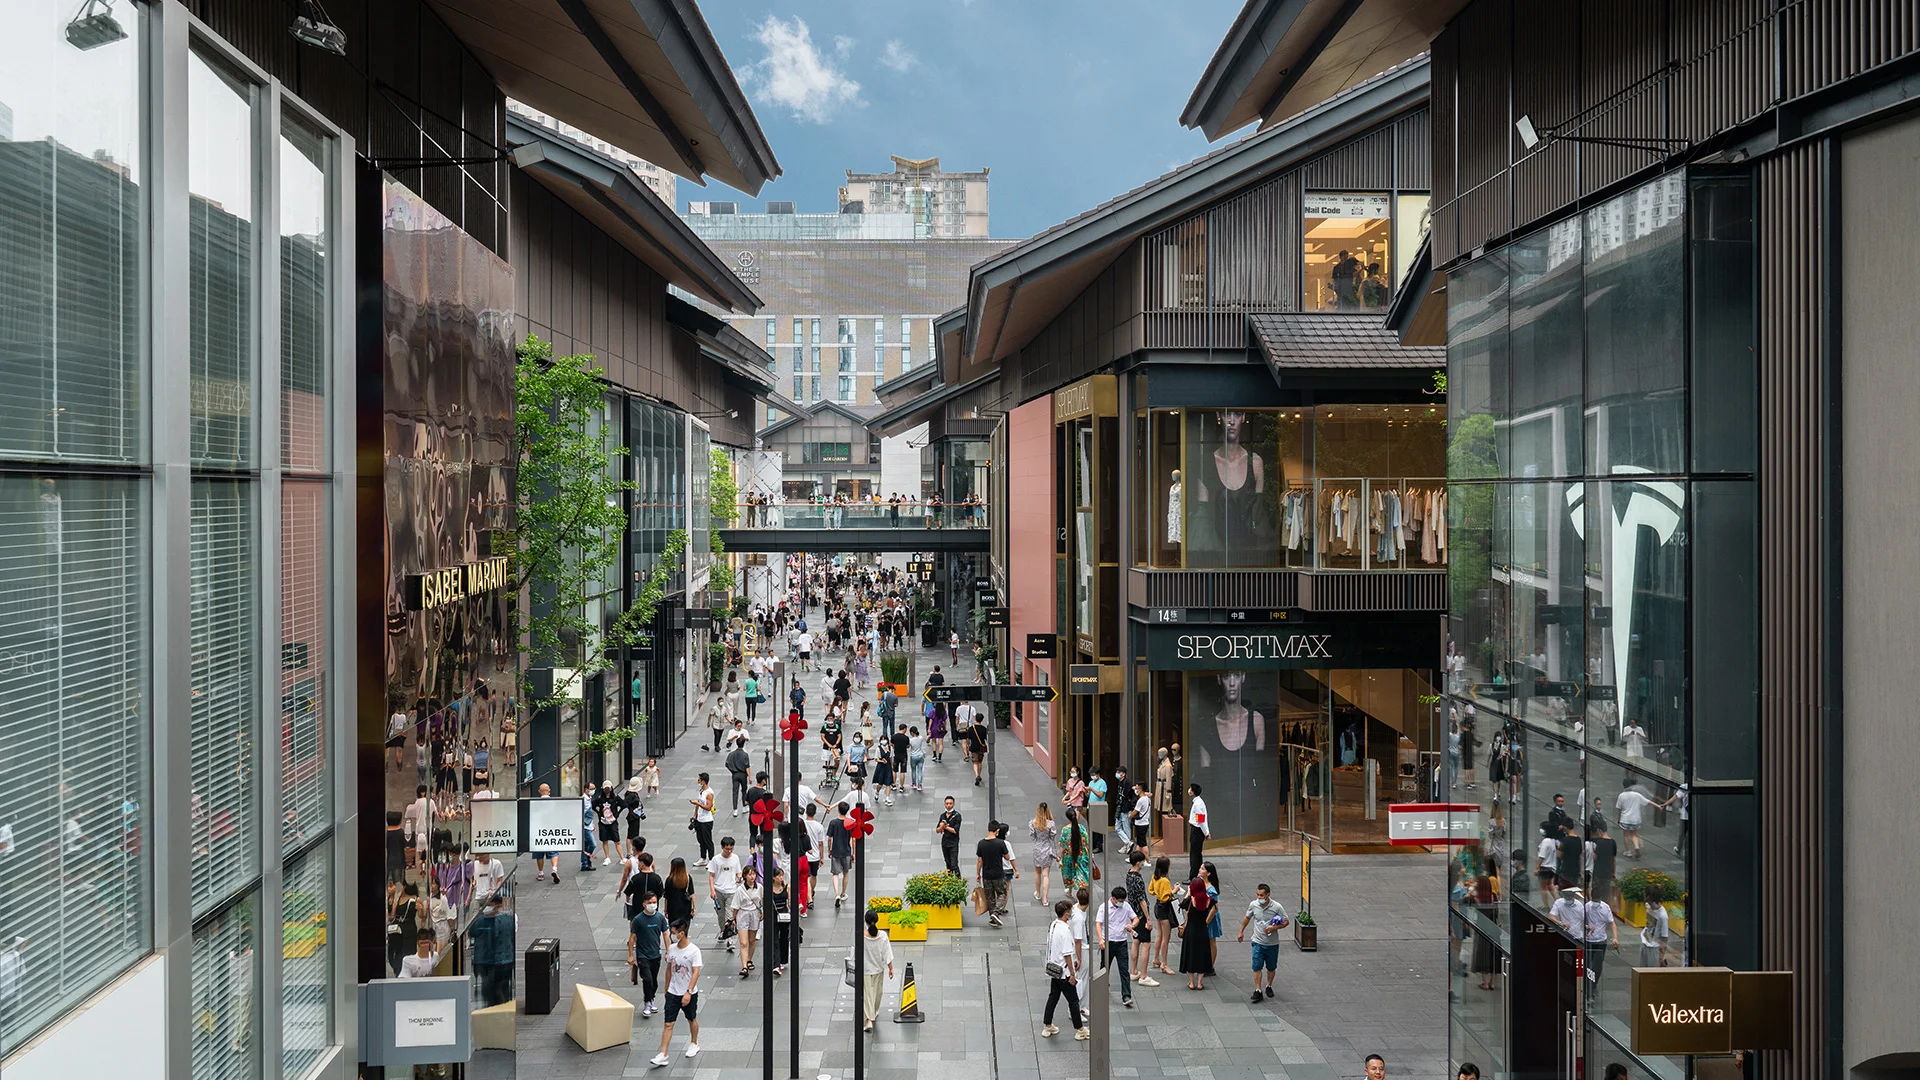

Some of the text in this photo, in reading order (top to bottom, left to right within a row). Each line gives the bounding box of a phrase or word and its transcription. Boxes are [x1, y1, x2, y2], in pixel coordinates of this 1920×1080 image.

[422, 558, 508, 611] ISABEL MARANT
[1177, 635, 1333, 659] SPORTMAX
[534, 838, 577, 846] MARANT
[1647, 1003, 1724, 1024] Valextra
